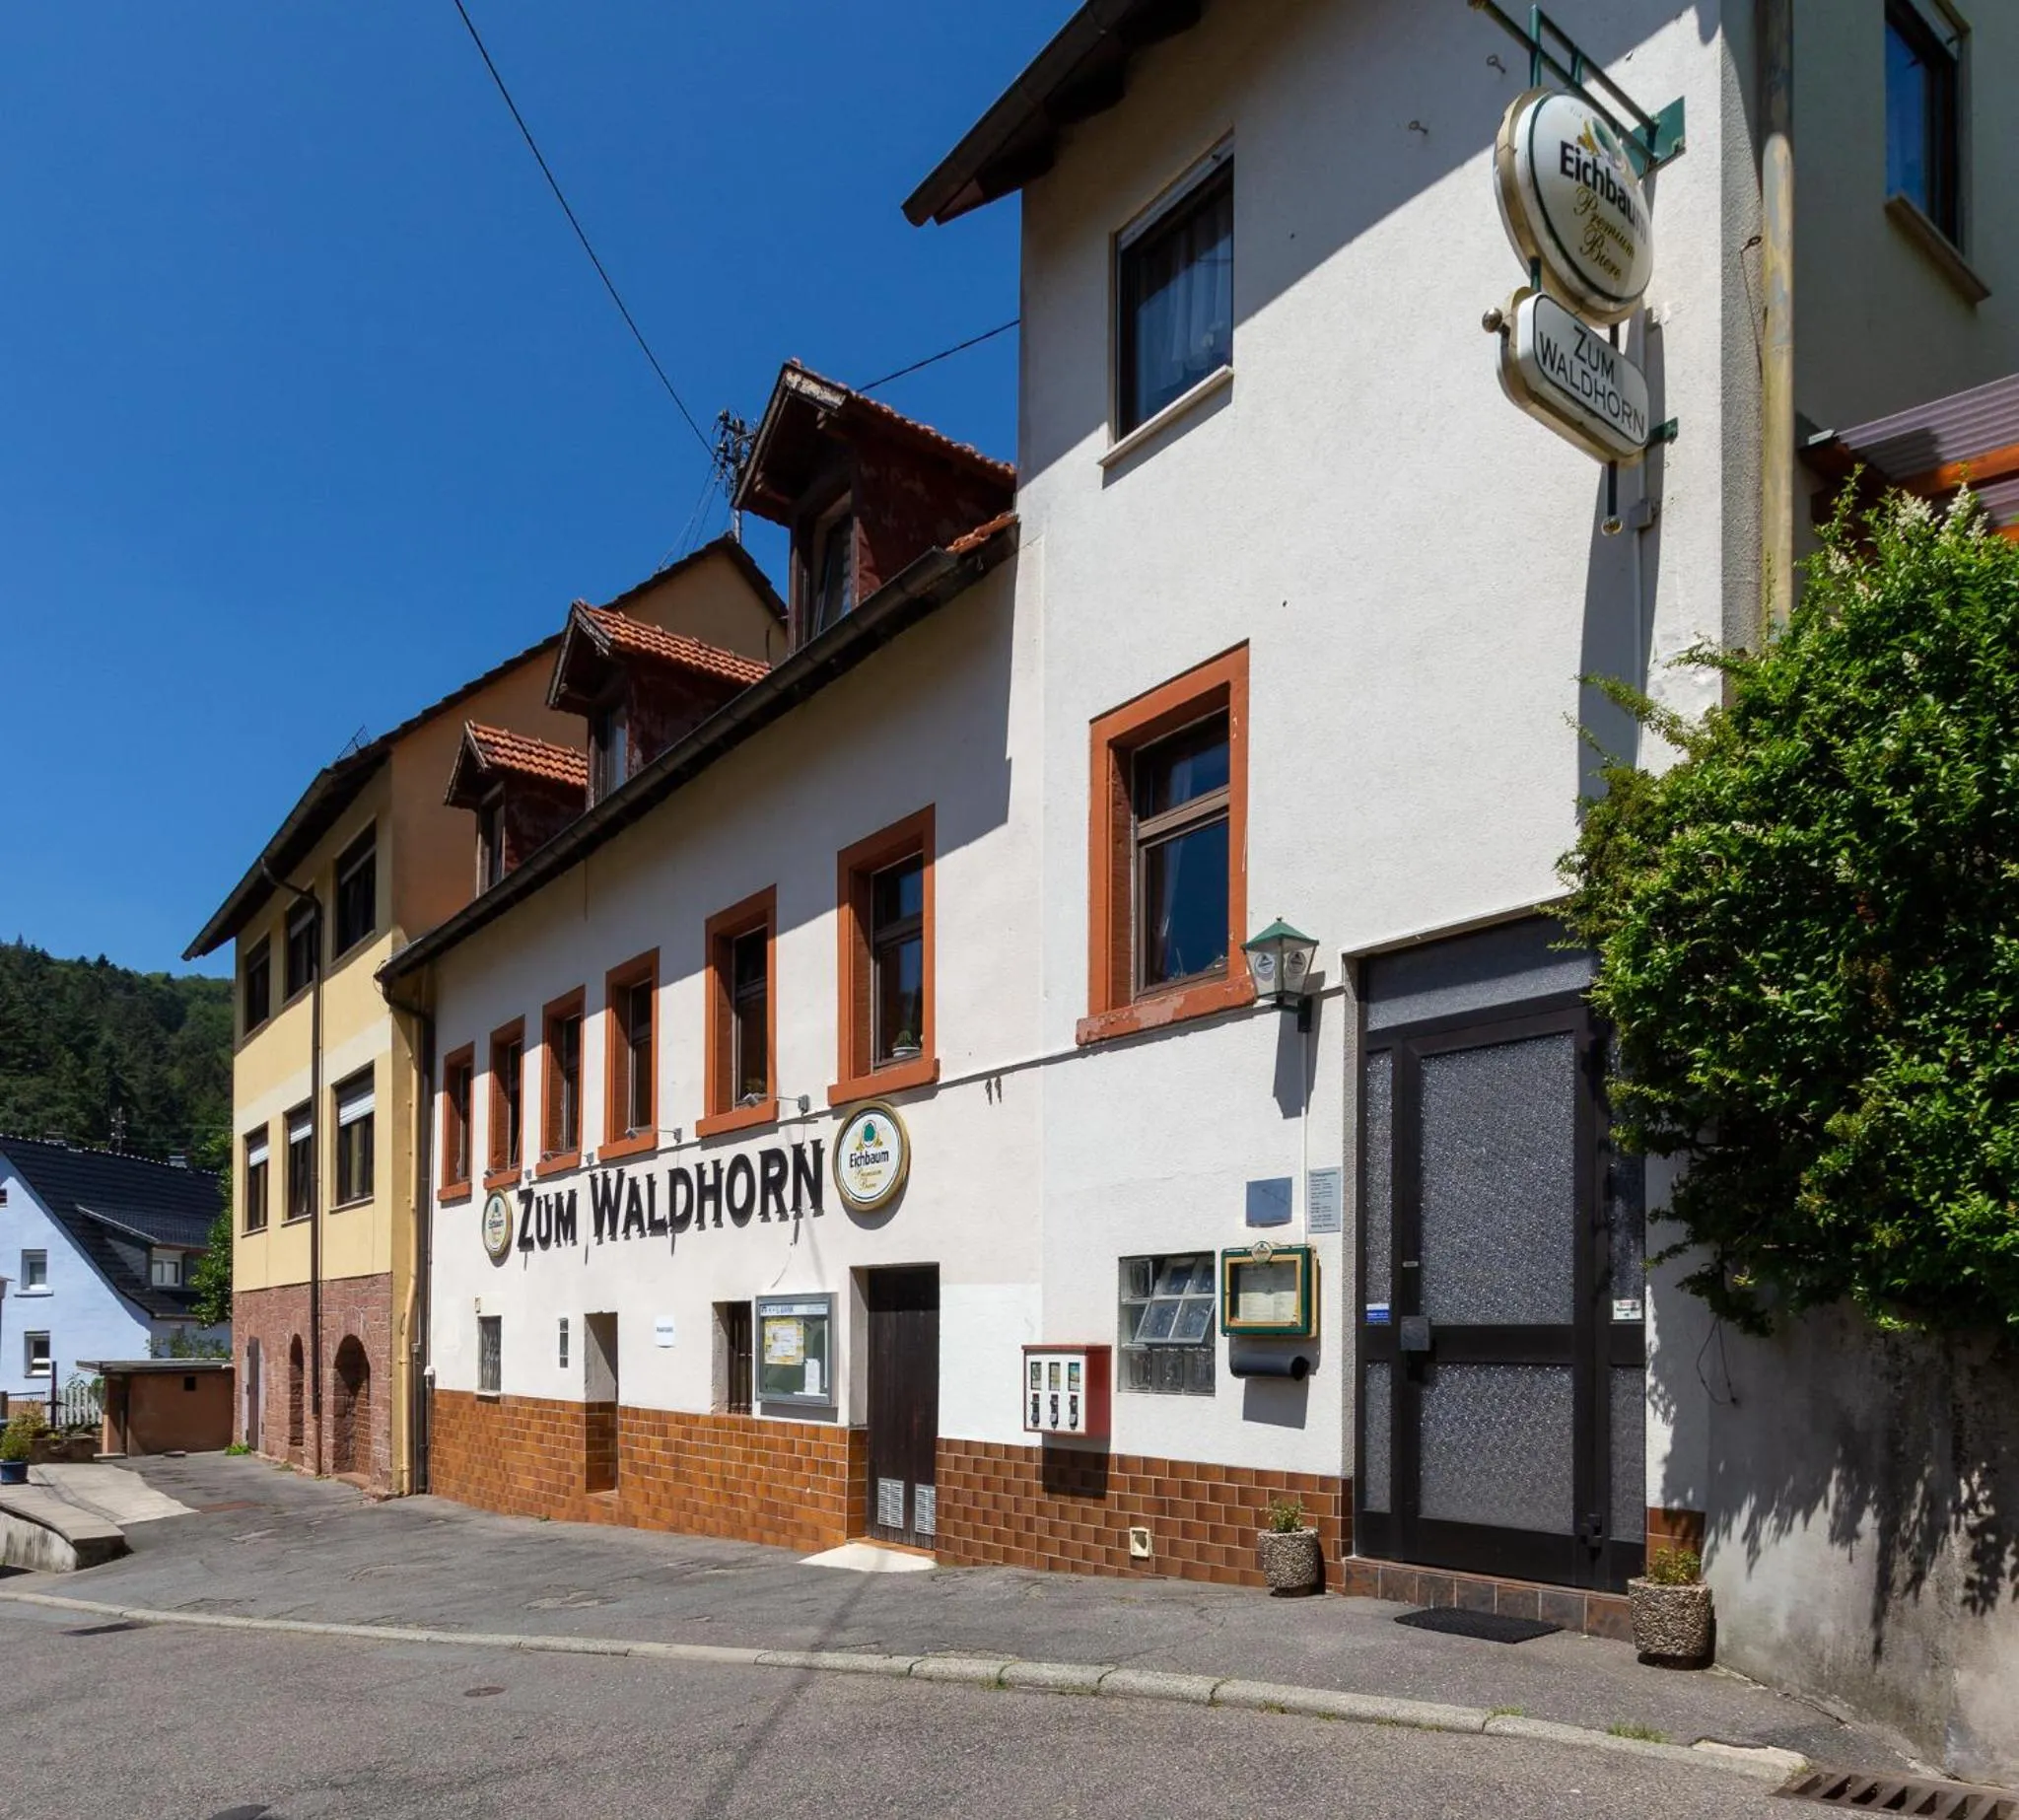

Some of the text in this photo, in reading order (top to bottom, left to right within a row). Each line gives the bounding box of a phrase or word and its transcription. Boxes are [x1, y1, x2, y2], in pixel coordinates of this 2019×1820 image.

[1560, 139, 1647, 245] Eichbaum
[1573, 185, 1635, 260] Premium
[1579, 224, 1623, 283] Biere
[1539, 330, 1645, 439] WALDHORN
[1573, 324, 1615, 385] ZUM
[517, 1139, 824, 1252] ZUM WALDHORN
[850, 1150, 890, 1168] Eichbaum
